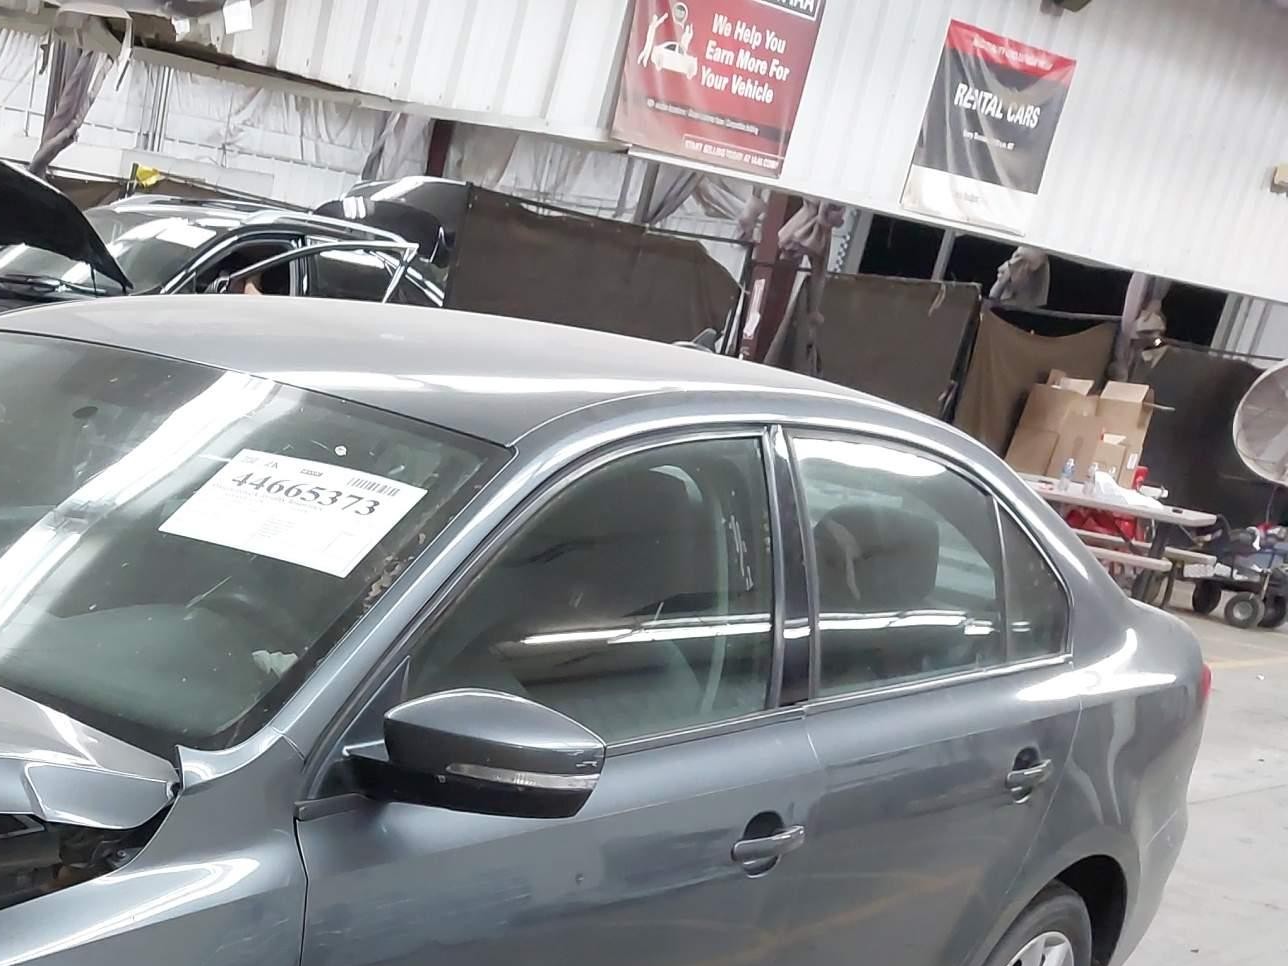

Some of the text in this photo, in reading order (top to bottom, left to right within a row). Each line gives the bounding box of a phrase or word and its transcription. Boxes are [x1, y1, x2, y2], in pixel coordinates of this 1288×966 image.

[712, 13, 786, 54] We Help You
[705, 40, 790, 81] Earn More For
[701, 65, 774, 104] Your Vehicle
[954, 82, 1040, 128] RENTAL CARS
[231, 472, 380, 516] 44665373
